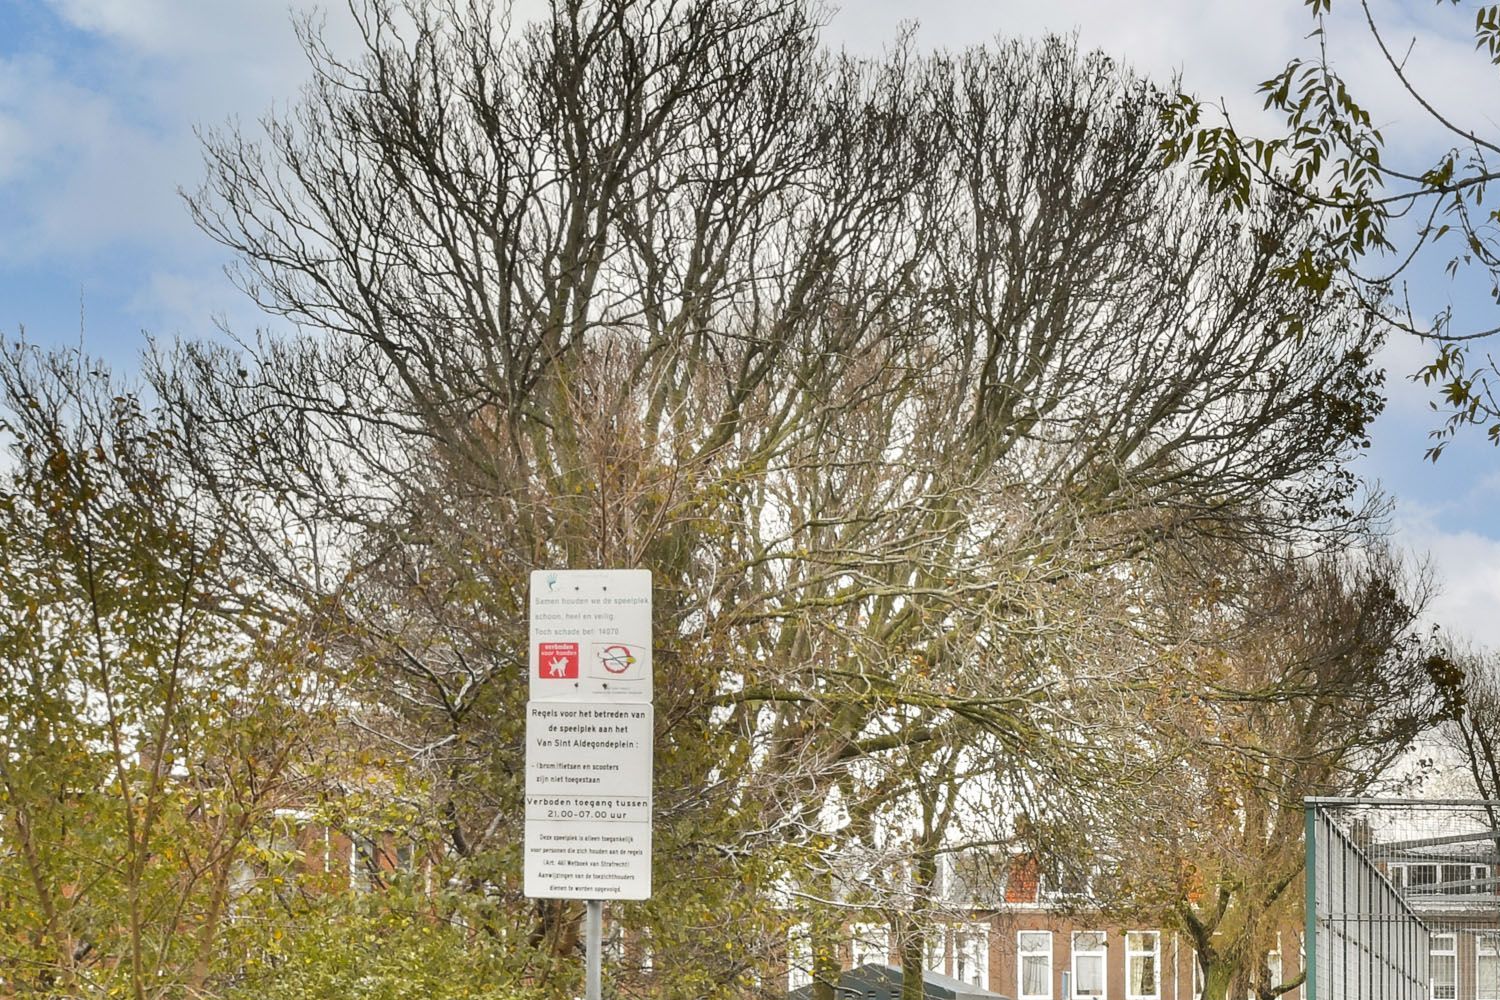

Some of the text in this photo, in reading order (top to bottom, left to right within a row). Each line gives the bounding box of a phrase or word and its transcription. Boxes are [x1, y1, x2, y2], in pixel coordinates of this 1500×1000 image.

[614, 597, 648, 606] speelplek
[532, 709, 558, 718] Regels
[579, 710, 592, 718] het
[594, 710, 628, 718] betreden
[560, 725, 596, 733] speelplek
[573, 740, 634, 749] Aldegondeplein
[575, 799, 612, 808] toegang
